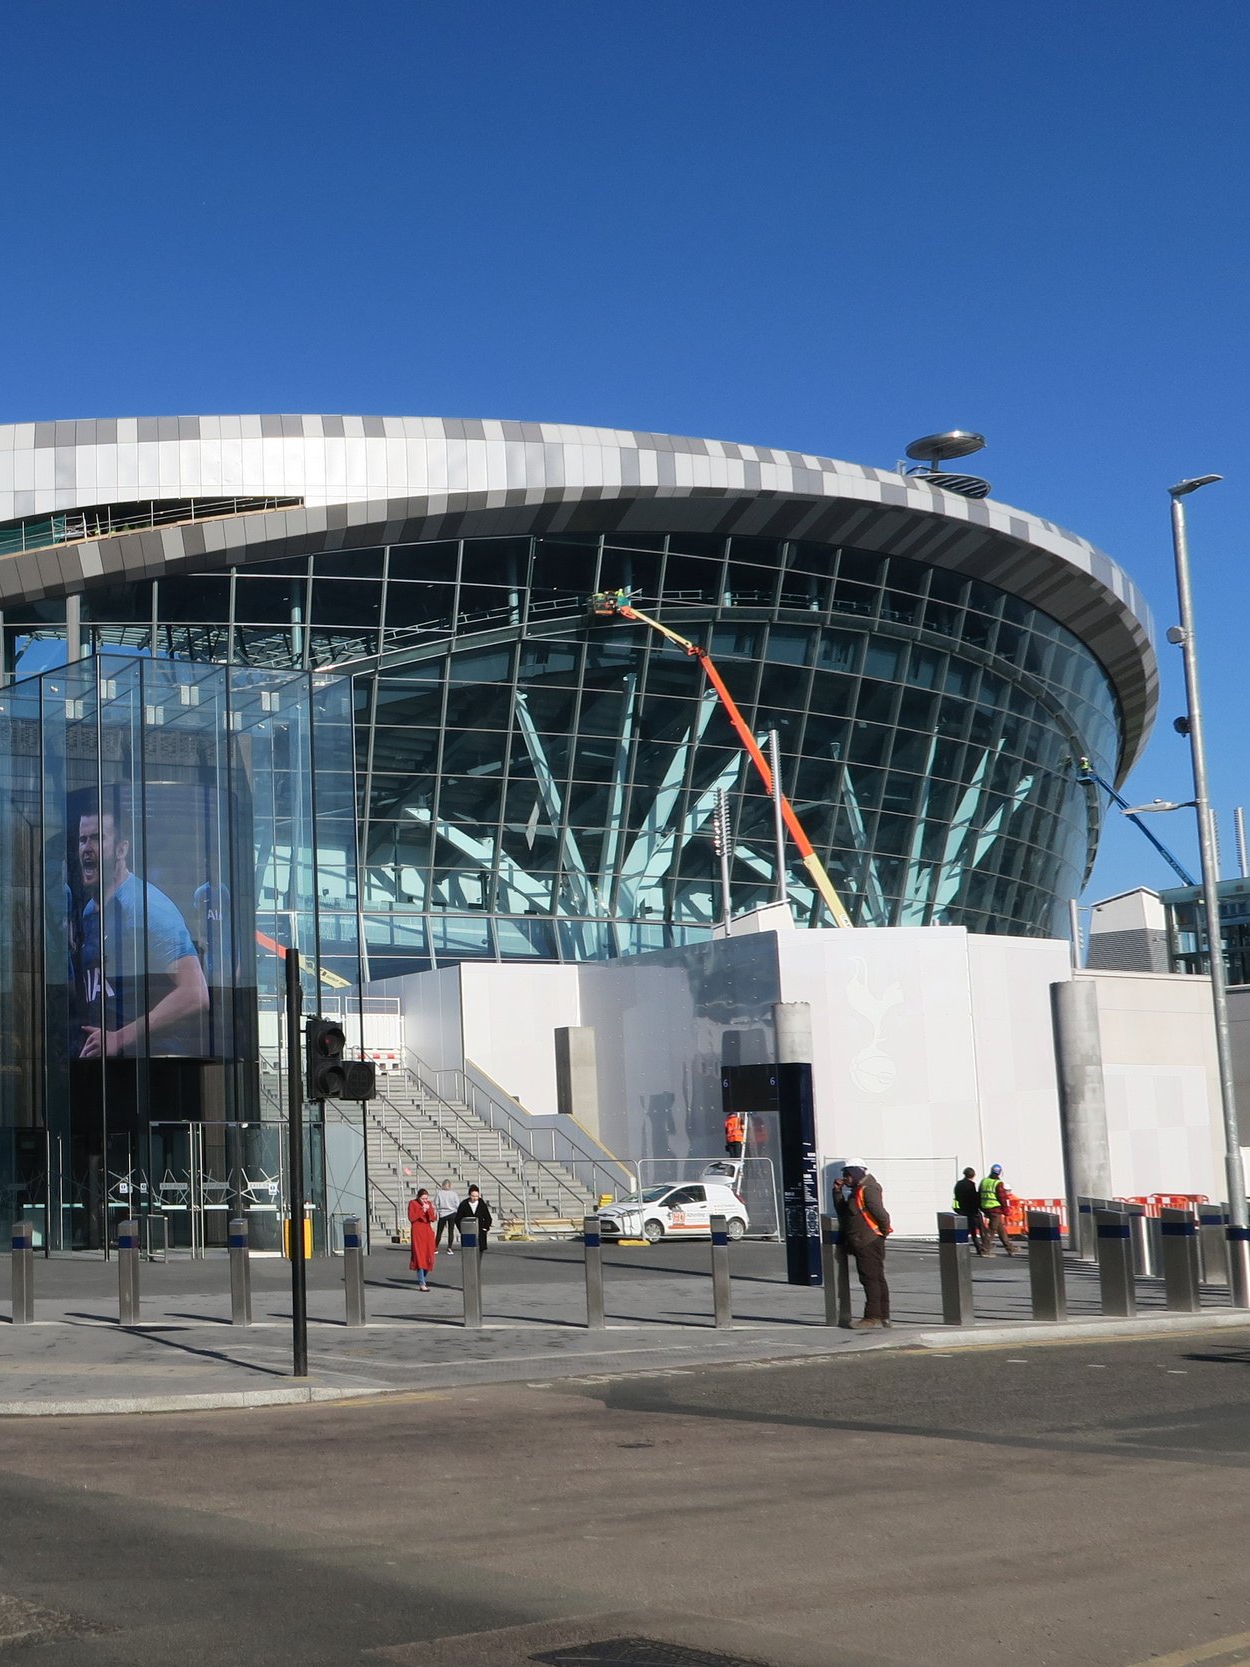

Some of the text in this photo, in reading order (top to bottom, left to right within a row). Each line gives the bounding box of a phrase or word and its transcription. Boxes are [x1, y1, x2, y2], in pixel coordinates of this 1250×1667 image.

[83, 966, 115, 1004] IA
[723, 1080, 728, 1088] 6
[770, 1077, 775, 1085] 6
